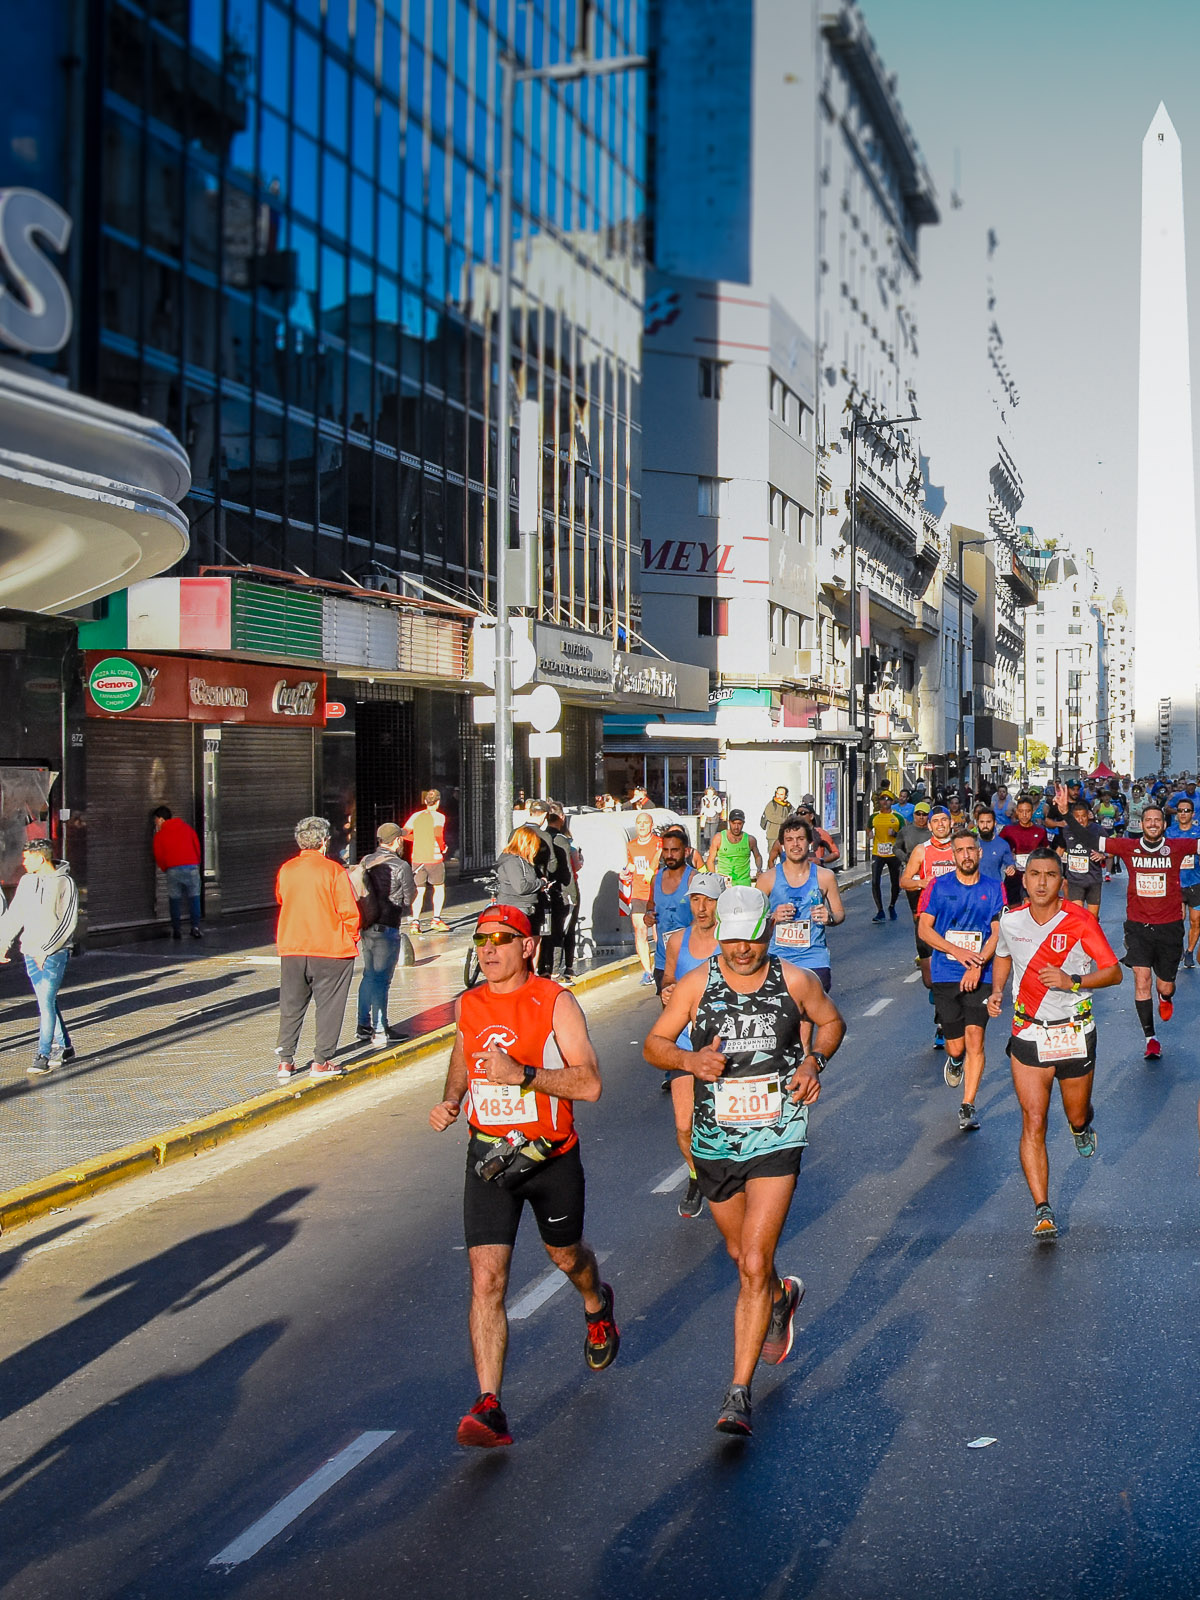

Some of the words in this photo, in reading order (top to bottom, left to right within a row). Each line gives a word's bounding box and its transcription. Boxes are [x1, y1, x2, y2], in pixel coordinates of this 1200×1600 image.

[561, 641, 589, 655] EDIFICIO
[538, 656, 558, 671] PLAZA
[96, 680, 134, 689] Genova
[206, 740, 219, 752] 872
[1131, 856, 1172, 868] YAMAHA
[1138, 880, 1164, 890] 13200
[781, 927, 804, 939] 7016
[1044, 1033, 1078, 1049] 4248
[480, 1099, 526, 1116] 4834
[728, 1093, 769, 1114] 2101
